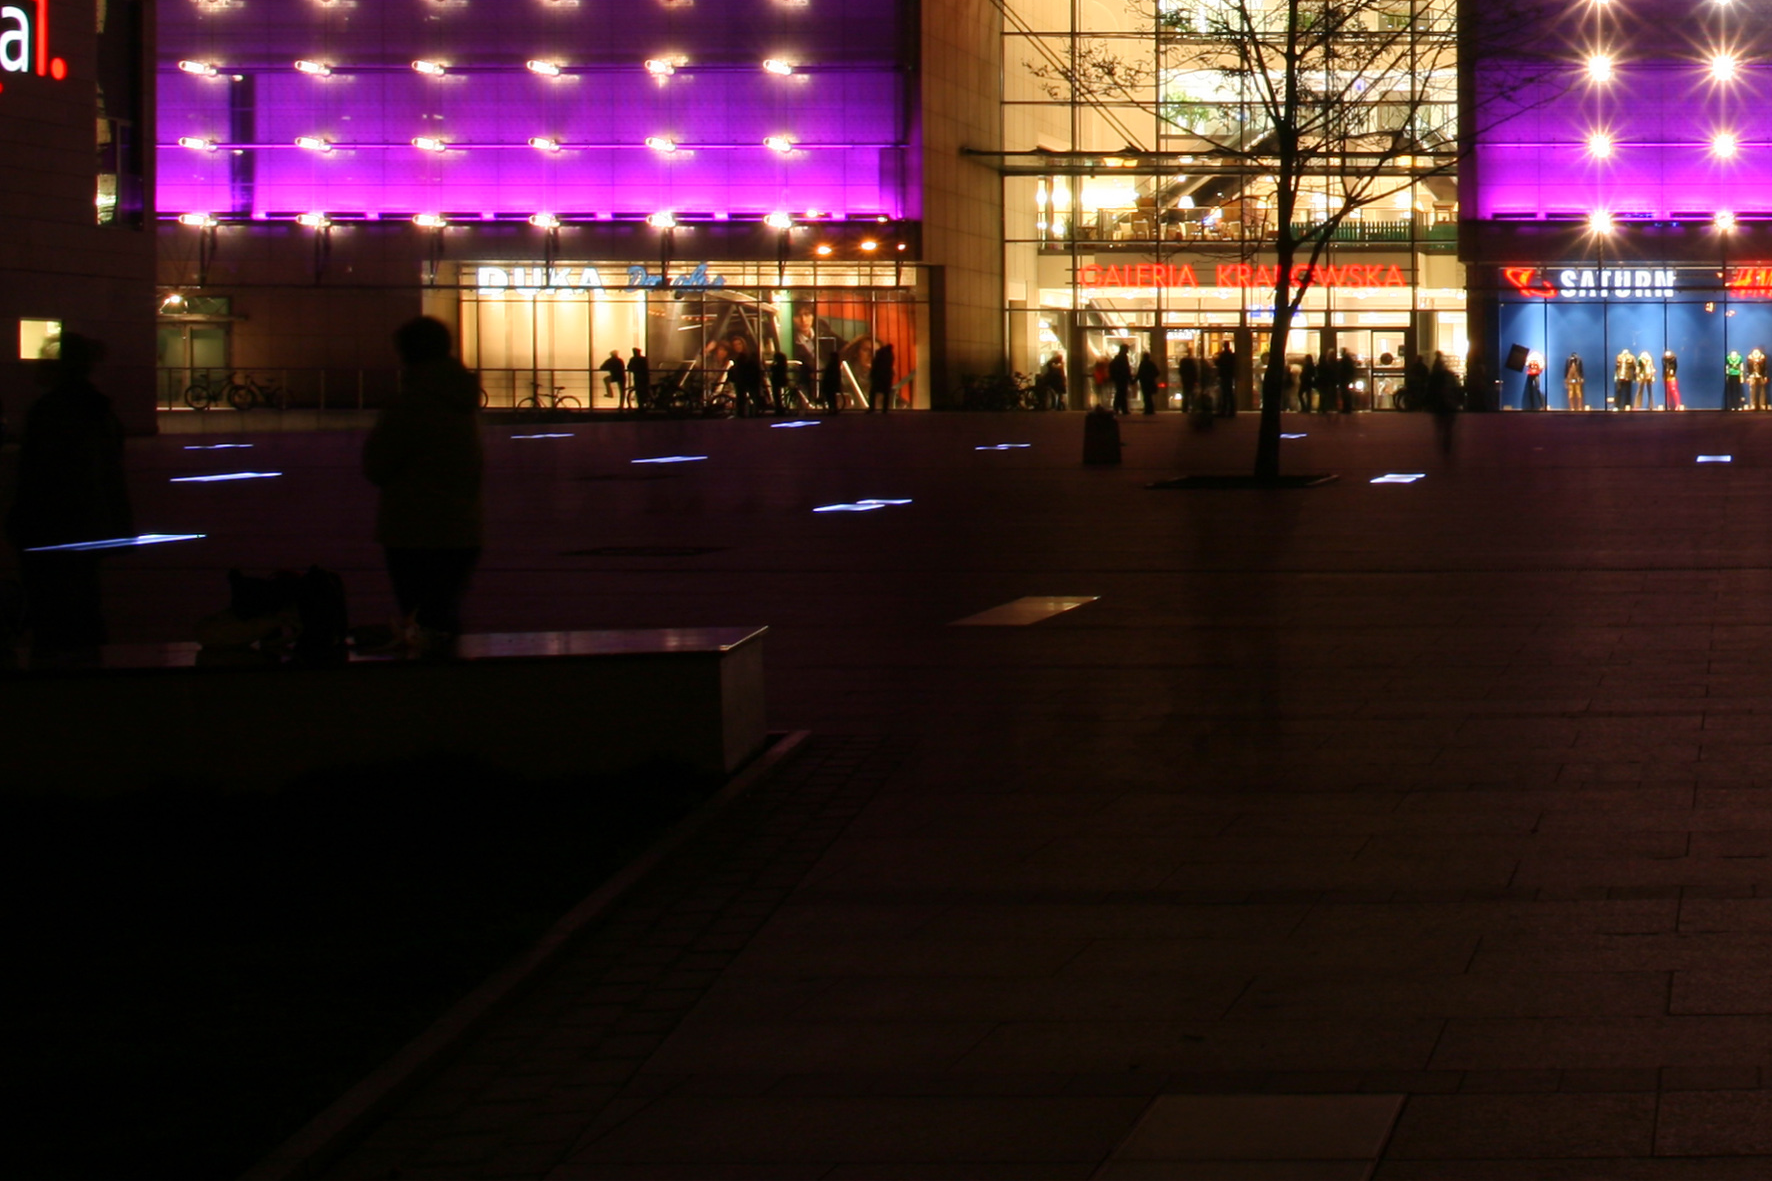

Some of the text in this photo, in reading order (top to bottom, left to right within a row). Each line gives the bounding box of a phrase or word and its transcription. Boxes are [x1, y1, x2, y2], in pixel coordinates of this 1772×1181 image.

[477, 266, 606, 296] DUKA
[626, 263, 726, 296] Doglas
[1079, 263, 1198, 288] GALERIA
[1560, 269, 1676, 298] SATURN
